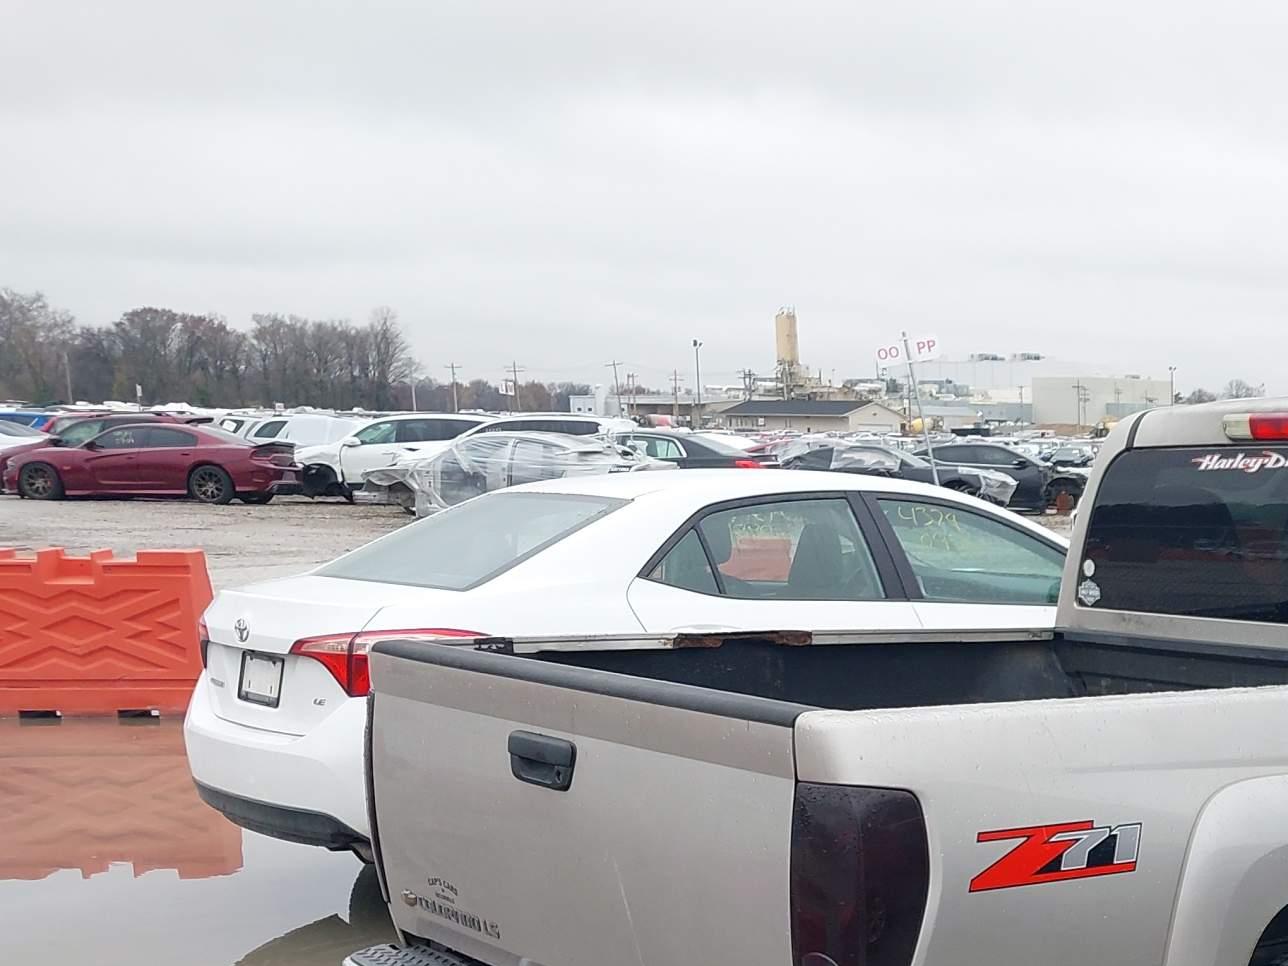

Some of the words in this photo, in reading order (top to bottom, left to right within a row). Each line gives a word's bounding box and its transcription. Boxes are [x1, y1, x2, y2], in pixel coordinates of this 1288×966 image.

[916, 340, 936, 354] PP
[312, 698, 327, 706] LE
[967, 818, 1143, 894] Z71
